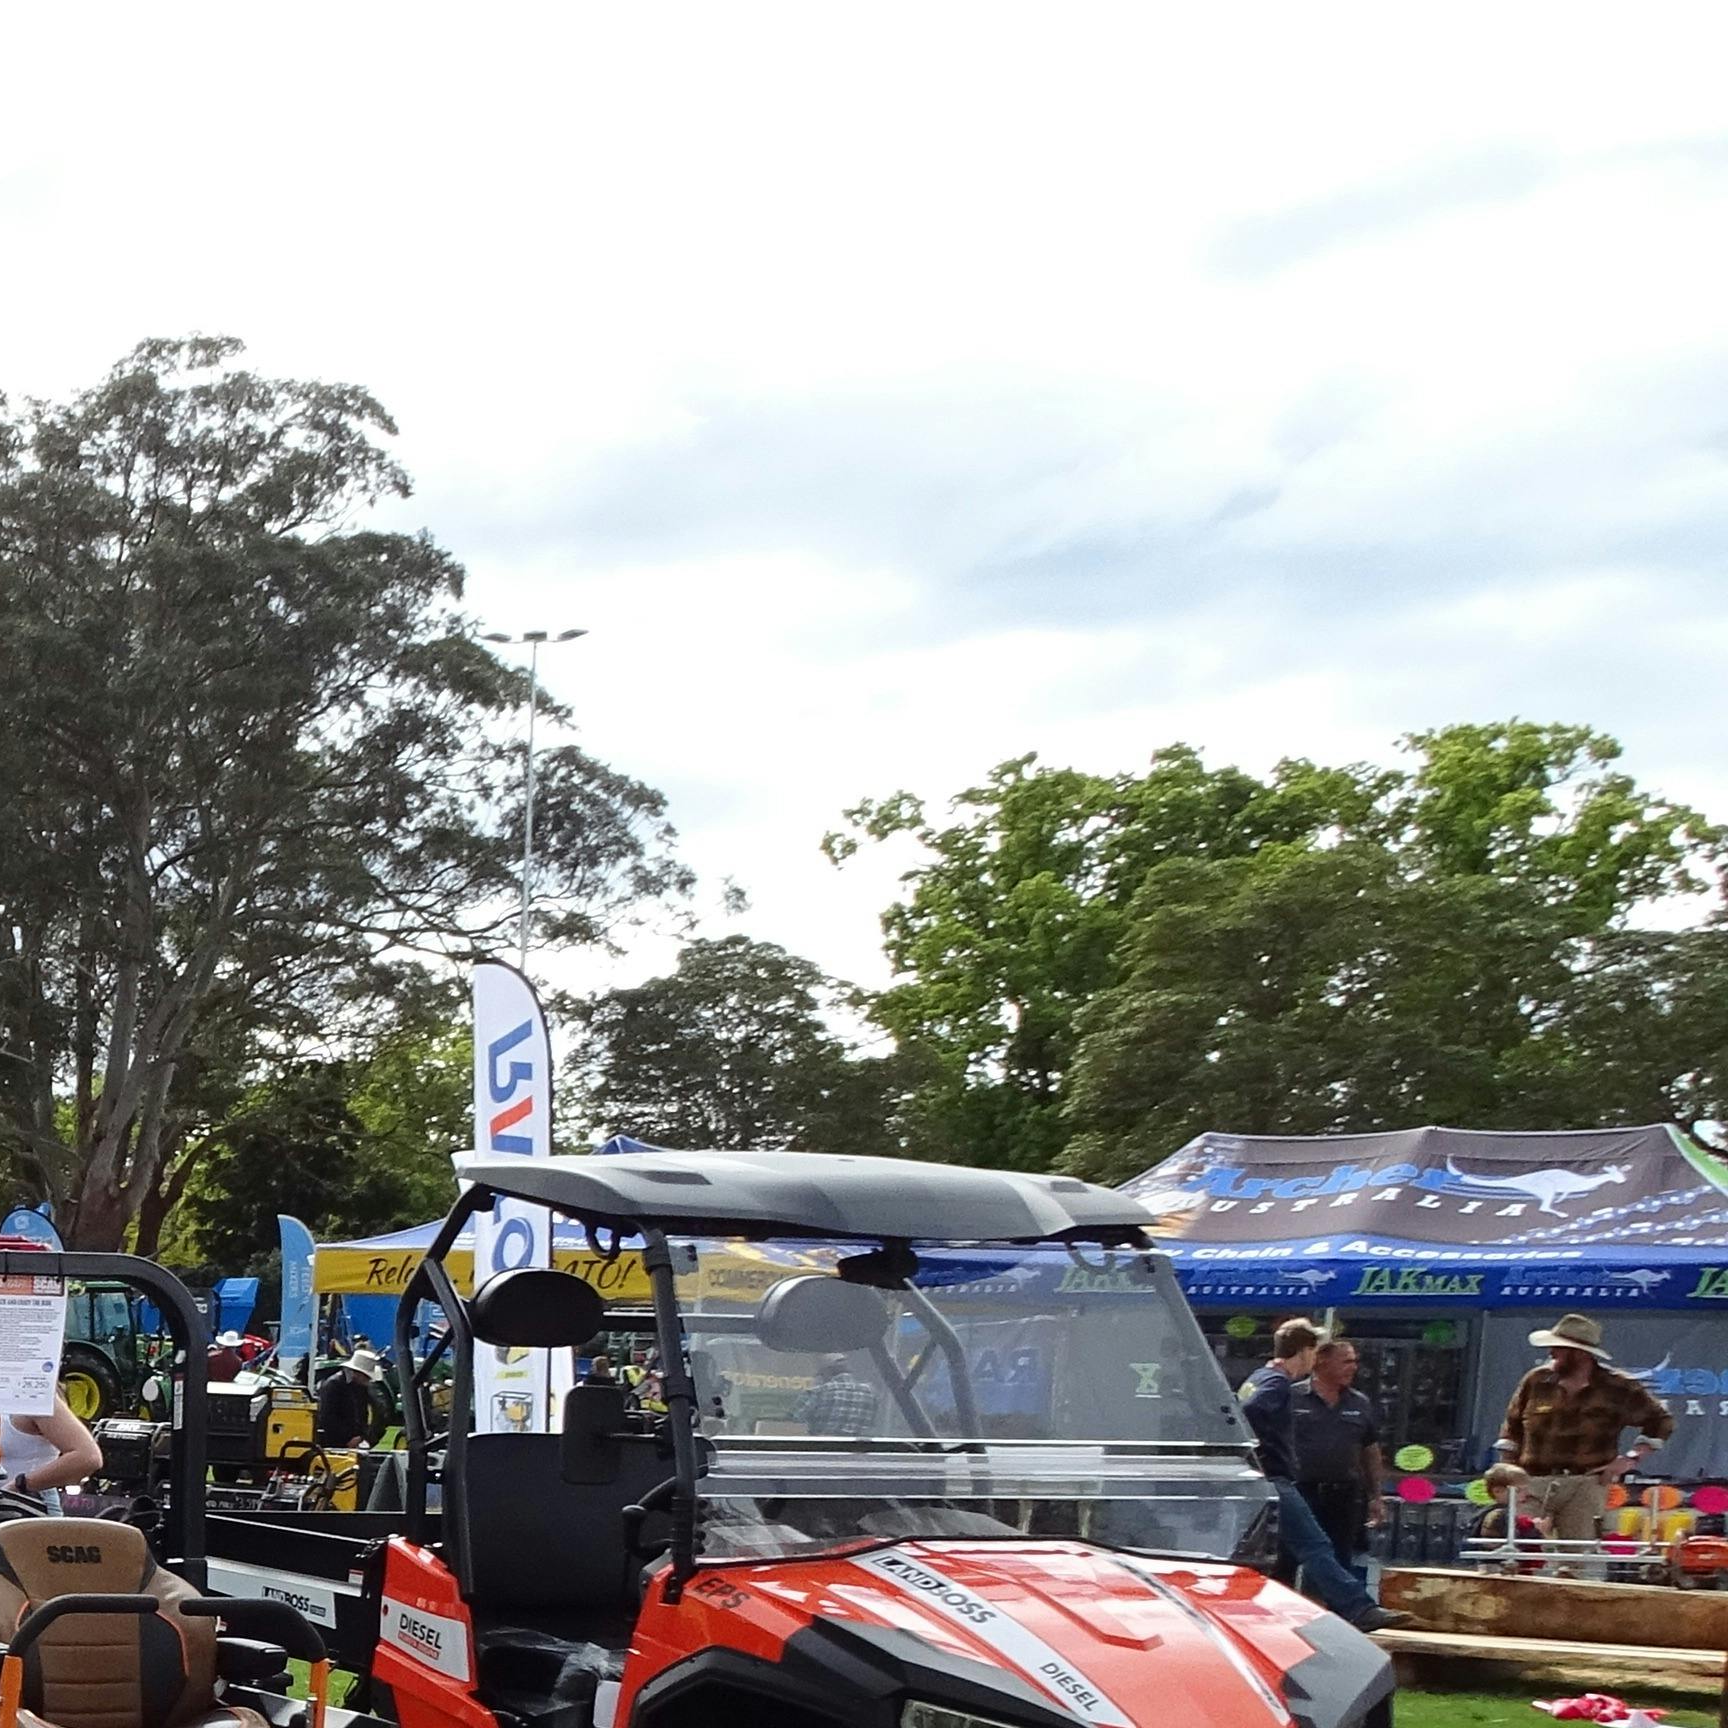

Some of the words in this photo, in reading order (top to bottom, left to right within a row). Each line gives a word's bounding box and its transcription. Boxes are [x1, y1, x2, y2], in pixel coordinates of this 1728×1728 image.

[1180, 1159, 1460, 1200] Archer
[1190, 1245, 1295, 1260] Chain
[1303, 1241, 1332, 1257] &
[1338, 1240, 1586, 1260] Accessories
[1186, 1285, 1312, 1297] AUSTRALIA
[1352, 1266, 1486, 1295] JAKMAX
[1499, 1286, 1641, 1297] AUSTRALIA
[45, 1544, 102, 1564] SCAG
[695, 1577, 752, 1609] EPS
[871, 1555, 998, 1625] LANDBOSS
[399, 1612, 443, 1650] DIESEL
[1039, 1661, 1102, 1713] DIESEL
